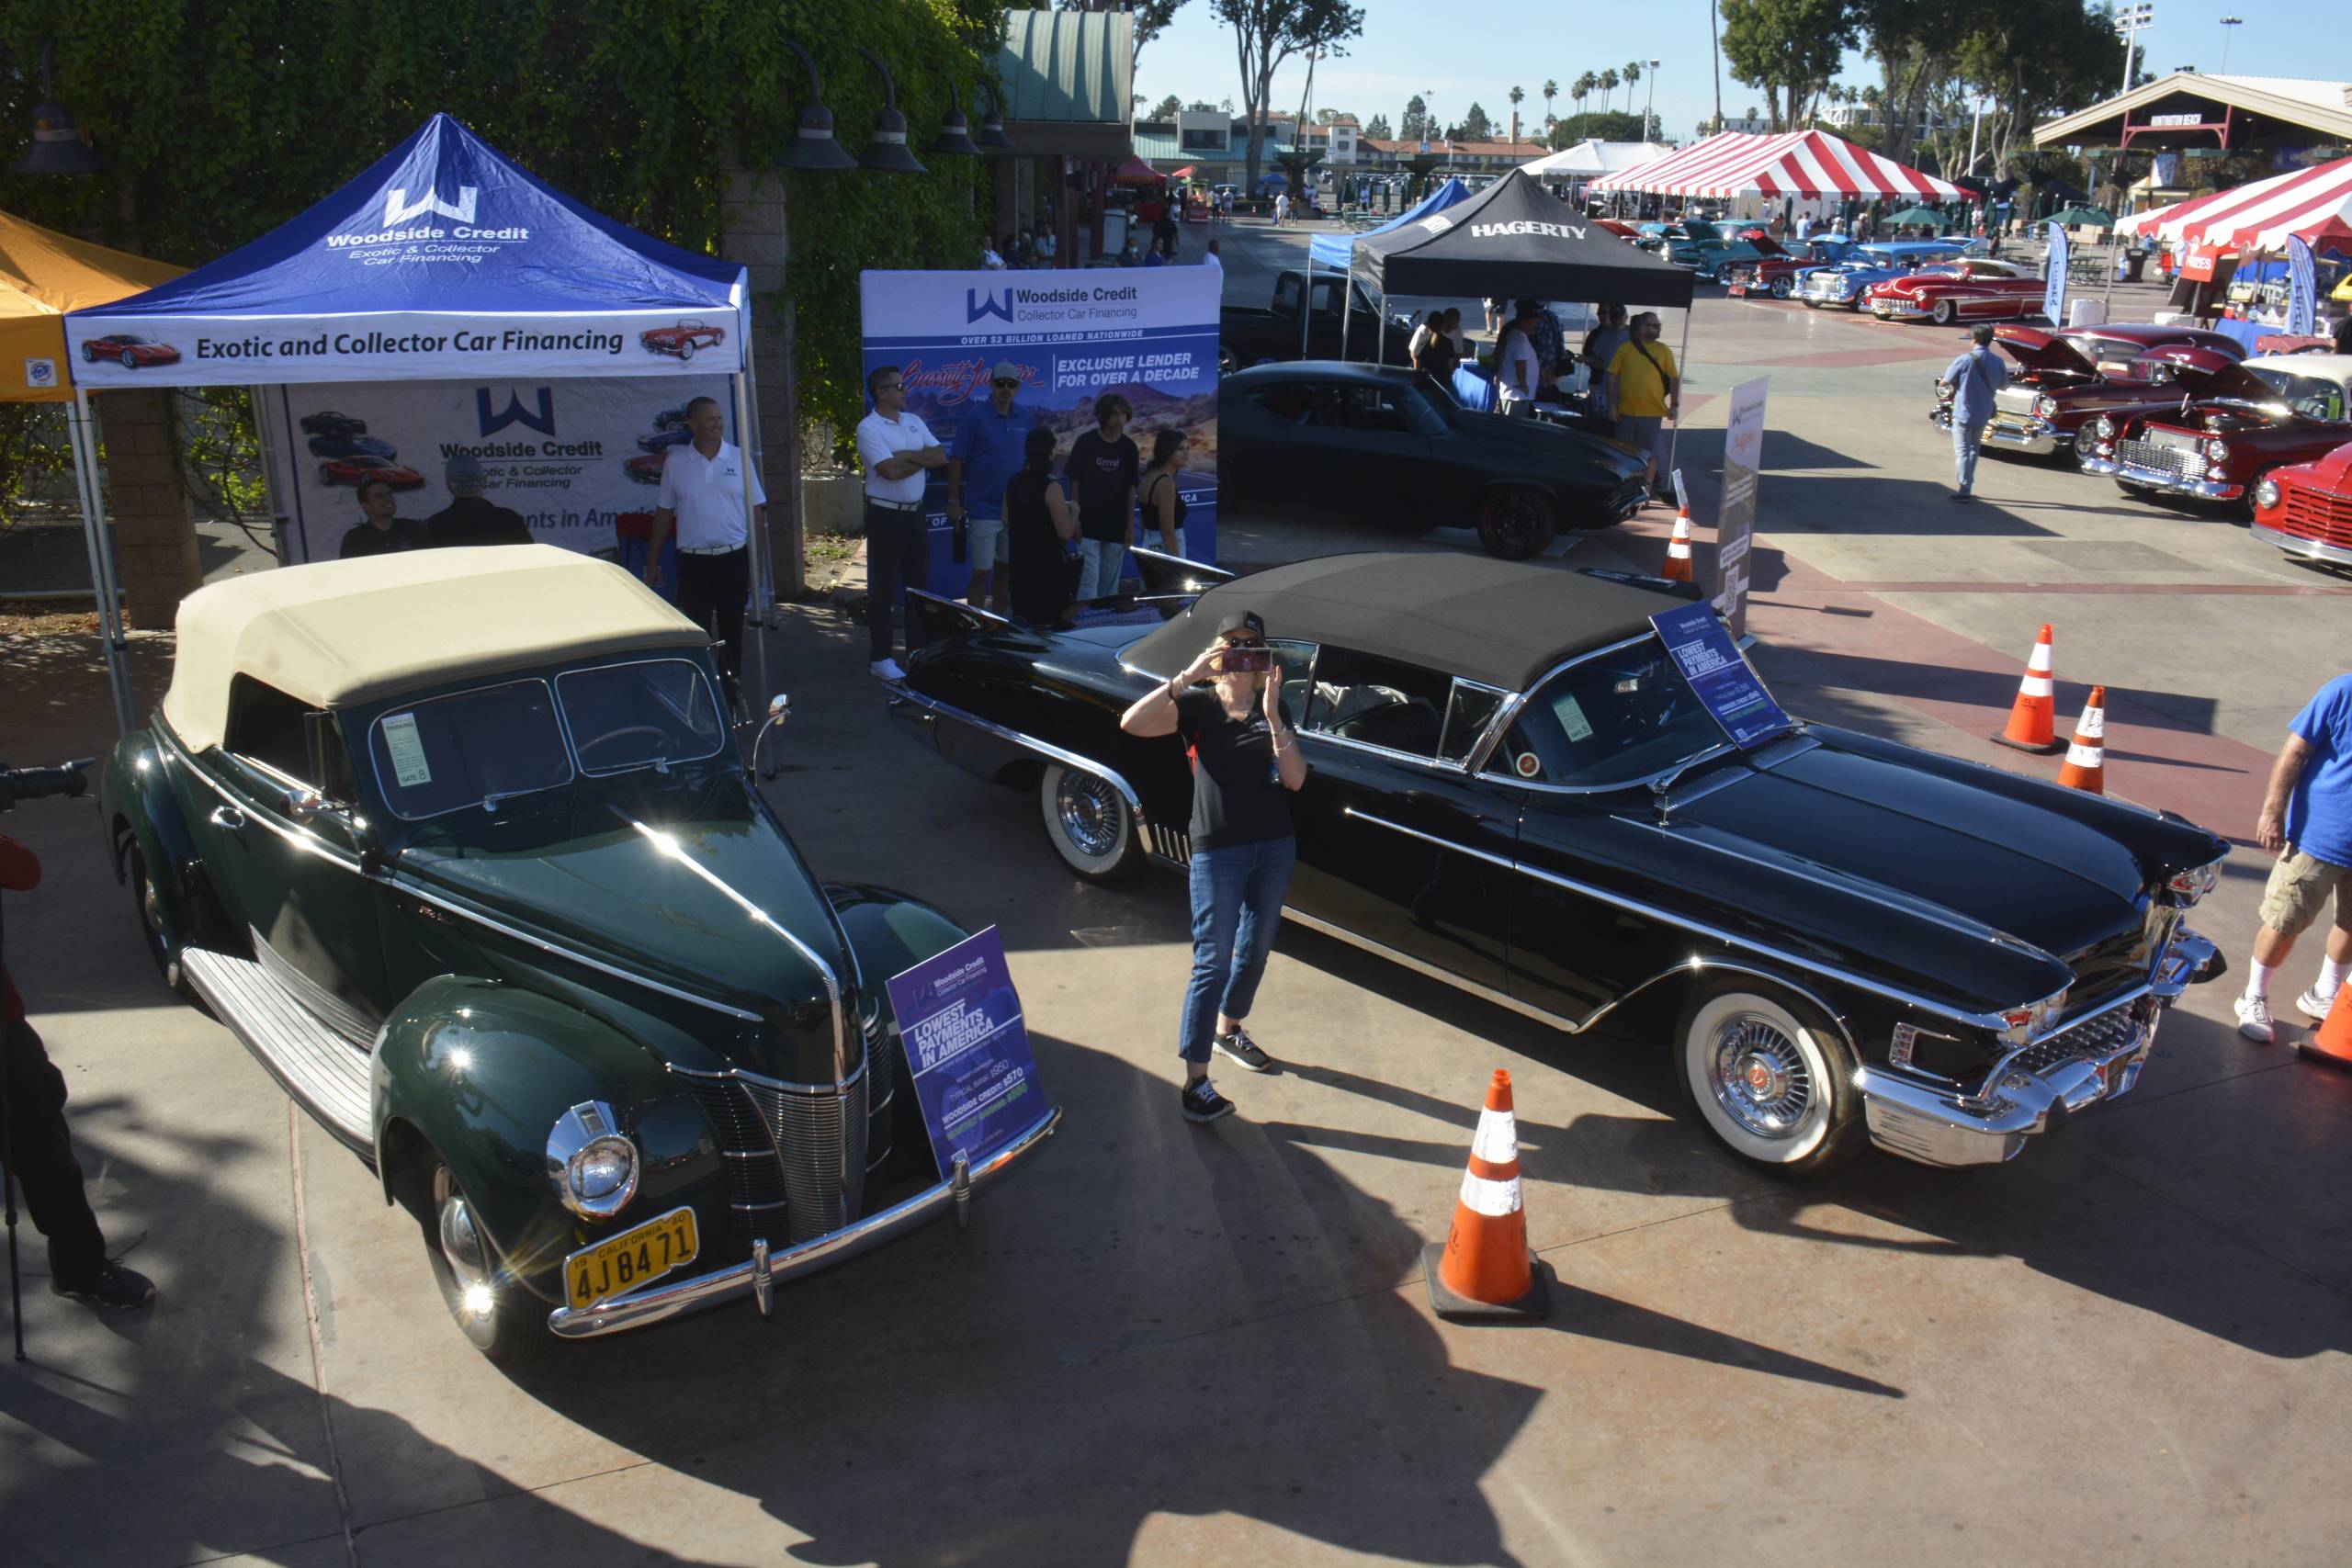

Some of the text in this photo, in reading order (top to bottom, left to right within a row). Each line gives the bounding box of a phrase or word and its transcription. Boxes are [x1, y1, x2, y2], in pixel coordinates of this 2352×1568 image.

[2184, 113, 2202, 125] BEACH
[327, 226, 530, 247] Woodside Credit
[1470, 220, 1587, 240] HAGERTY
[349, 244, 501, 260] Exotic & Collector
[363, 254, 483, 266] Car Financing
[2186, 255, 2213, 271] PRIZES
[1017, 287, 1138, 304] Woodside Credit
[1017, 306, 1138, 321] Collector Car Financing
[197, 329, 625, 359] Exotic and Collector Car Financing
[961, 336, 987, 345] OVER
[1005, 334, 1044, 344] BILLION
[1046, 332, 1084, 342] LOANED
[1087, 329, 1145, 341] NATIONWIDE
[1057, 352, 1193, 373] EXCLUSIVE LENDER
[1057, 367, 1200, 388] FOR OVER A DECADE
[439, 441, 604, 459] Woodside Credit
[509, 466, 521, 476] &
[523, 465, 583, 477] Collector
[506, 477, 572, 490] Financing
[561, 509, 579, 528] in
[933, 516, 948, 526] OF
[1678, 642, 1706, 660] LOWEST
[1682, 648, 1720, 668] PAYMENTS
[1697, 655, 1728, 673] AMERICA
[418, 769, 426, 780] 8
[933, 956, 985, 988] Woodside Credit
[914, 1003, 967, 1043] LOWEST
[918, 1009, 984, 1055] PAYMENTS
[922, 1050, 936, 1068] IN
[939, 1017, 995, 1060] AMERICA
[991, 1059, 1010, 1077] $950
[942, 1097, 978, 1123] WOODSIDE
[1002, 1066, 1023, 1087] $570
[598, 1224, 663, 1258] CALIFORNIA
